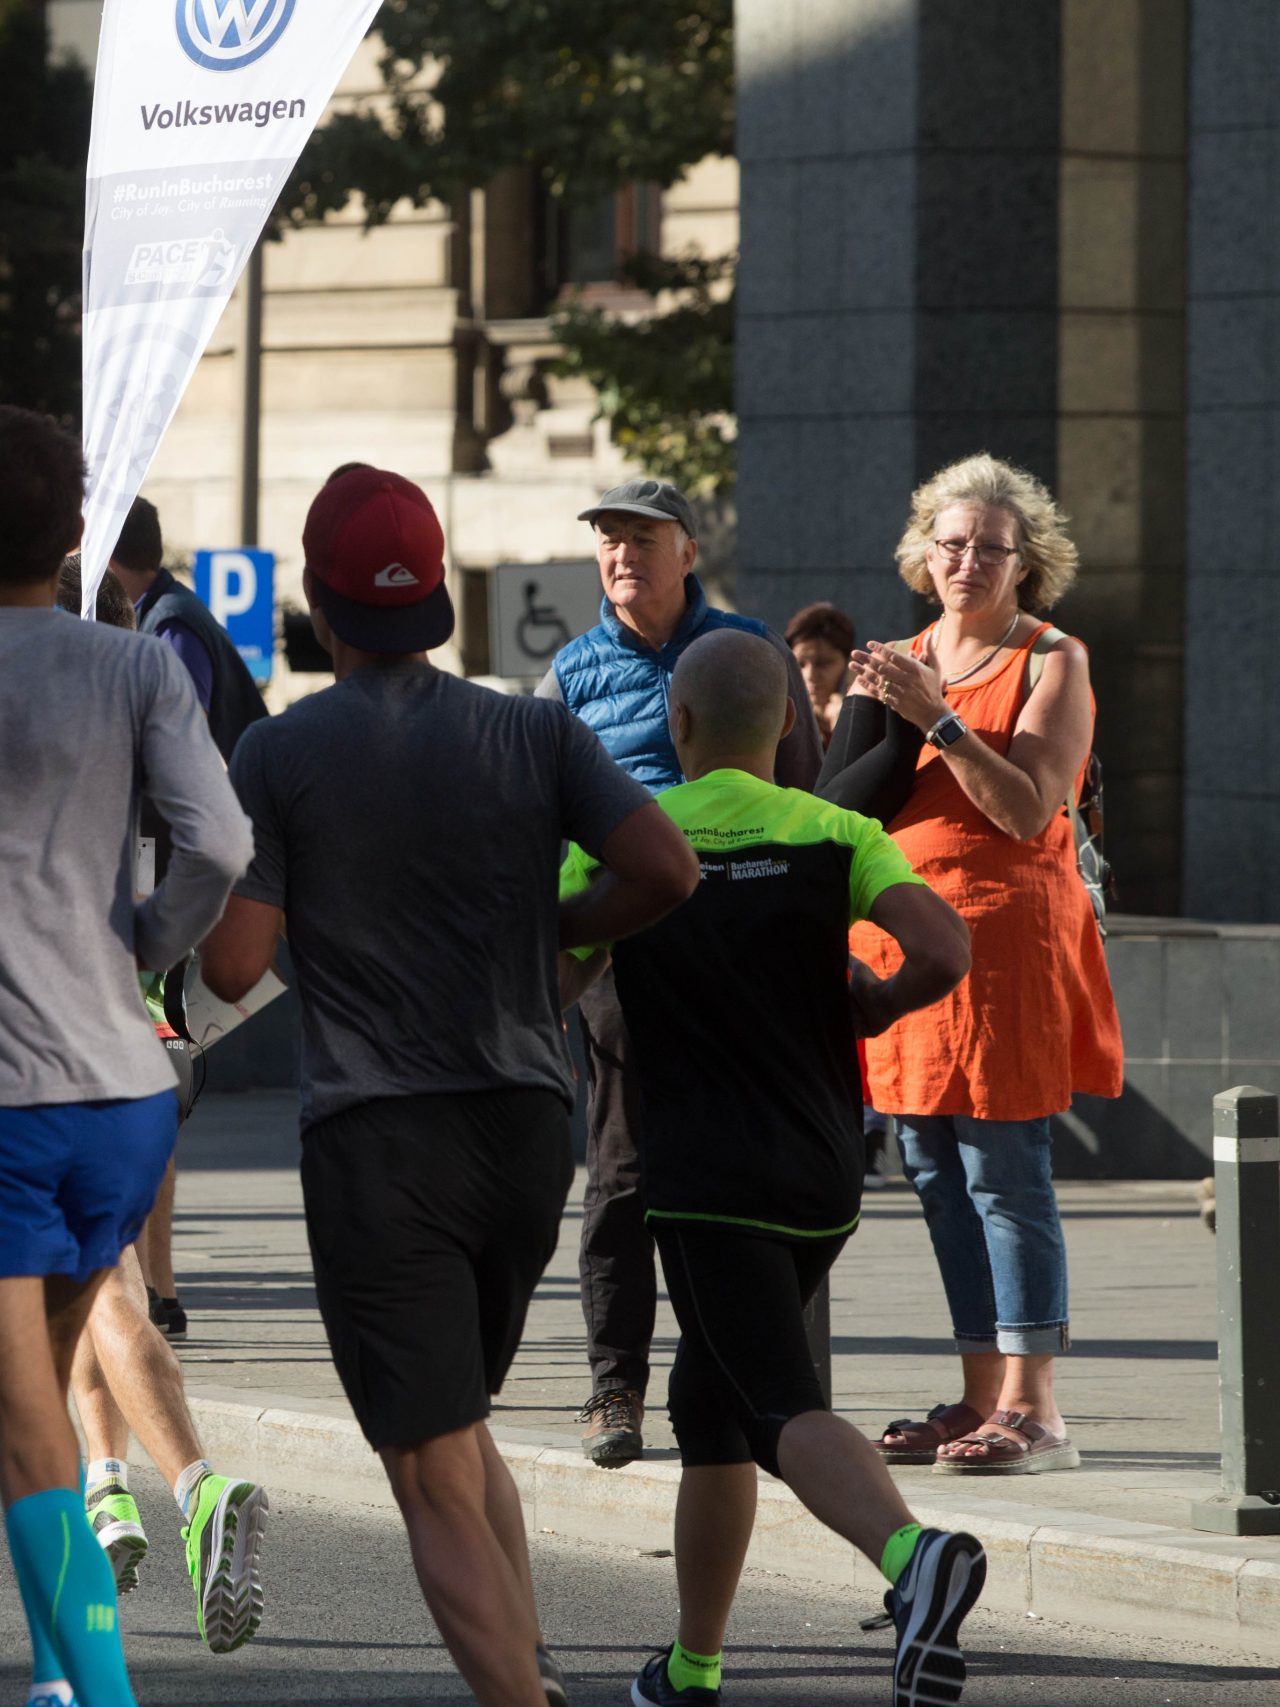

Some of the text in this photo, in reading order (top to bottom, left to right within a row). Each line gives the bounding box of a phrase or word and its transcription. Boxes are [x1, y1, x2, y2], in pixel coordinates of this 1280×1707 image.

[140, 98, 305, 130] Volkswagen
[113, 174, 272, 203] #RunInBucharest
[111, 204, 135, 220] City
[136, 203, 148, 217] of
[178, 198, 203, 214] City
[204, 196, 217, 210] of
[134, 240, 199, 269] PACE
[210, 553, 257, 627] P
[683, 827, 764, 839] RunInBucharest
[700, 861, 725, 871] eisen
[730, 858, 772, 871] Bucharest
[731, 864, 788, 880] MARATHON
